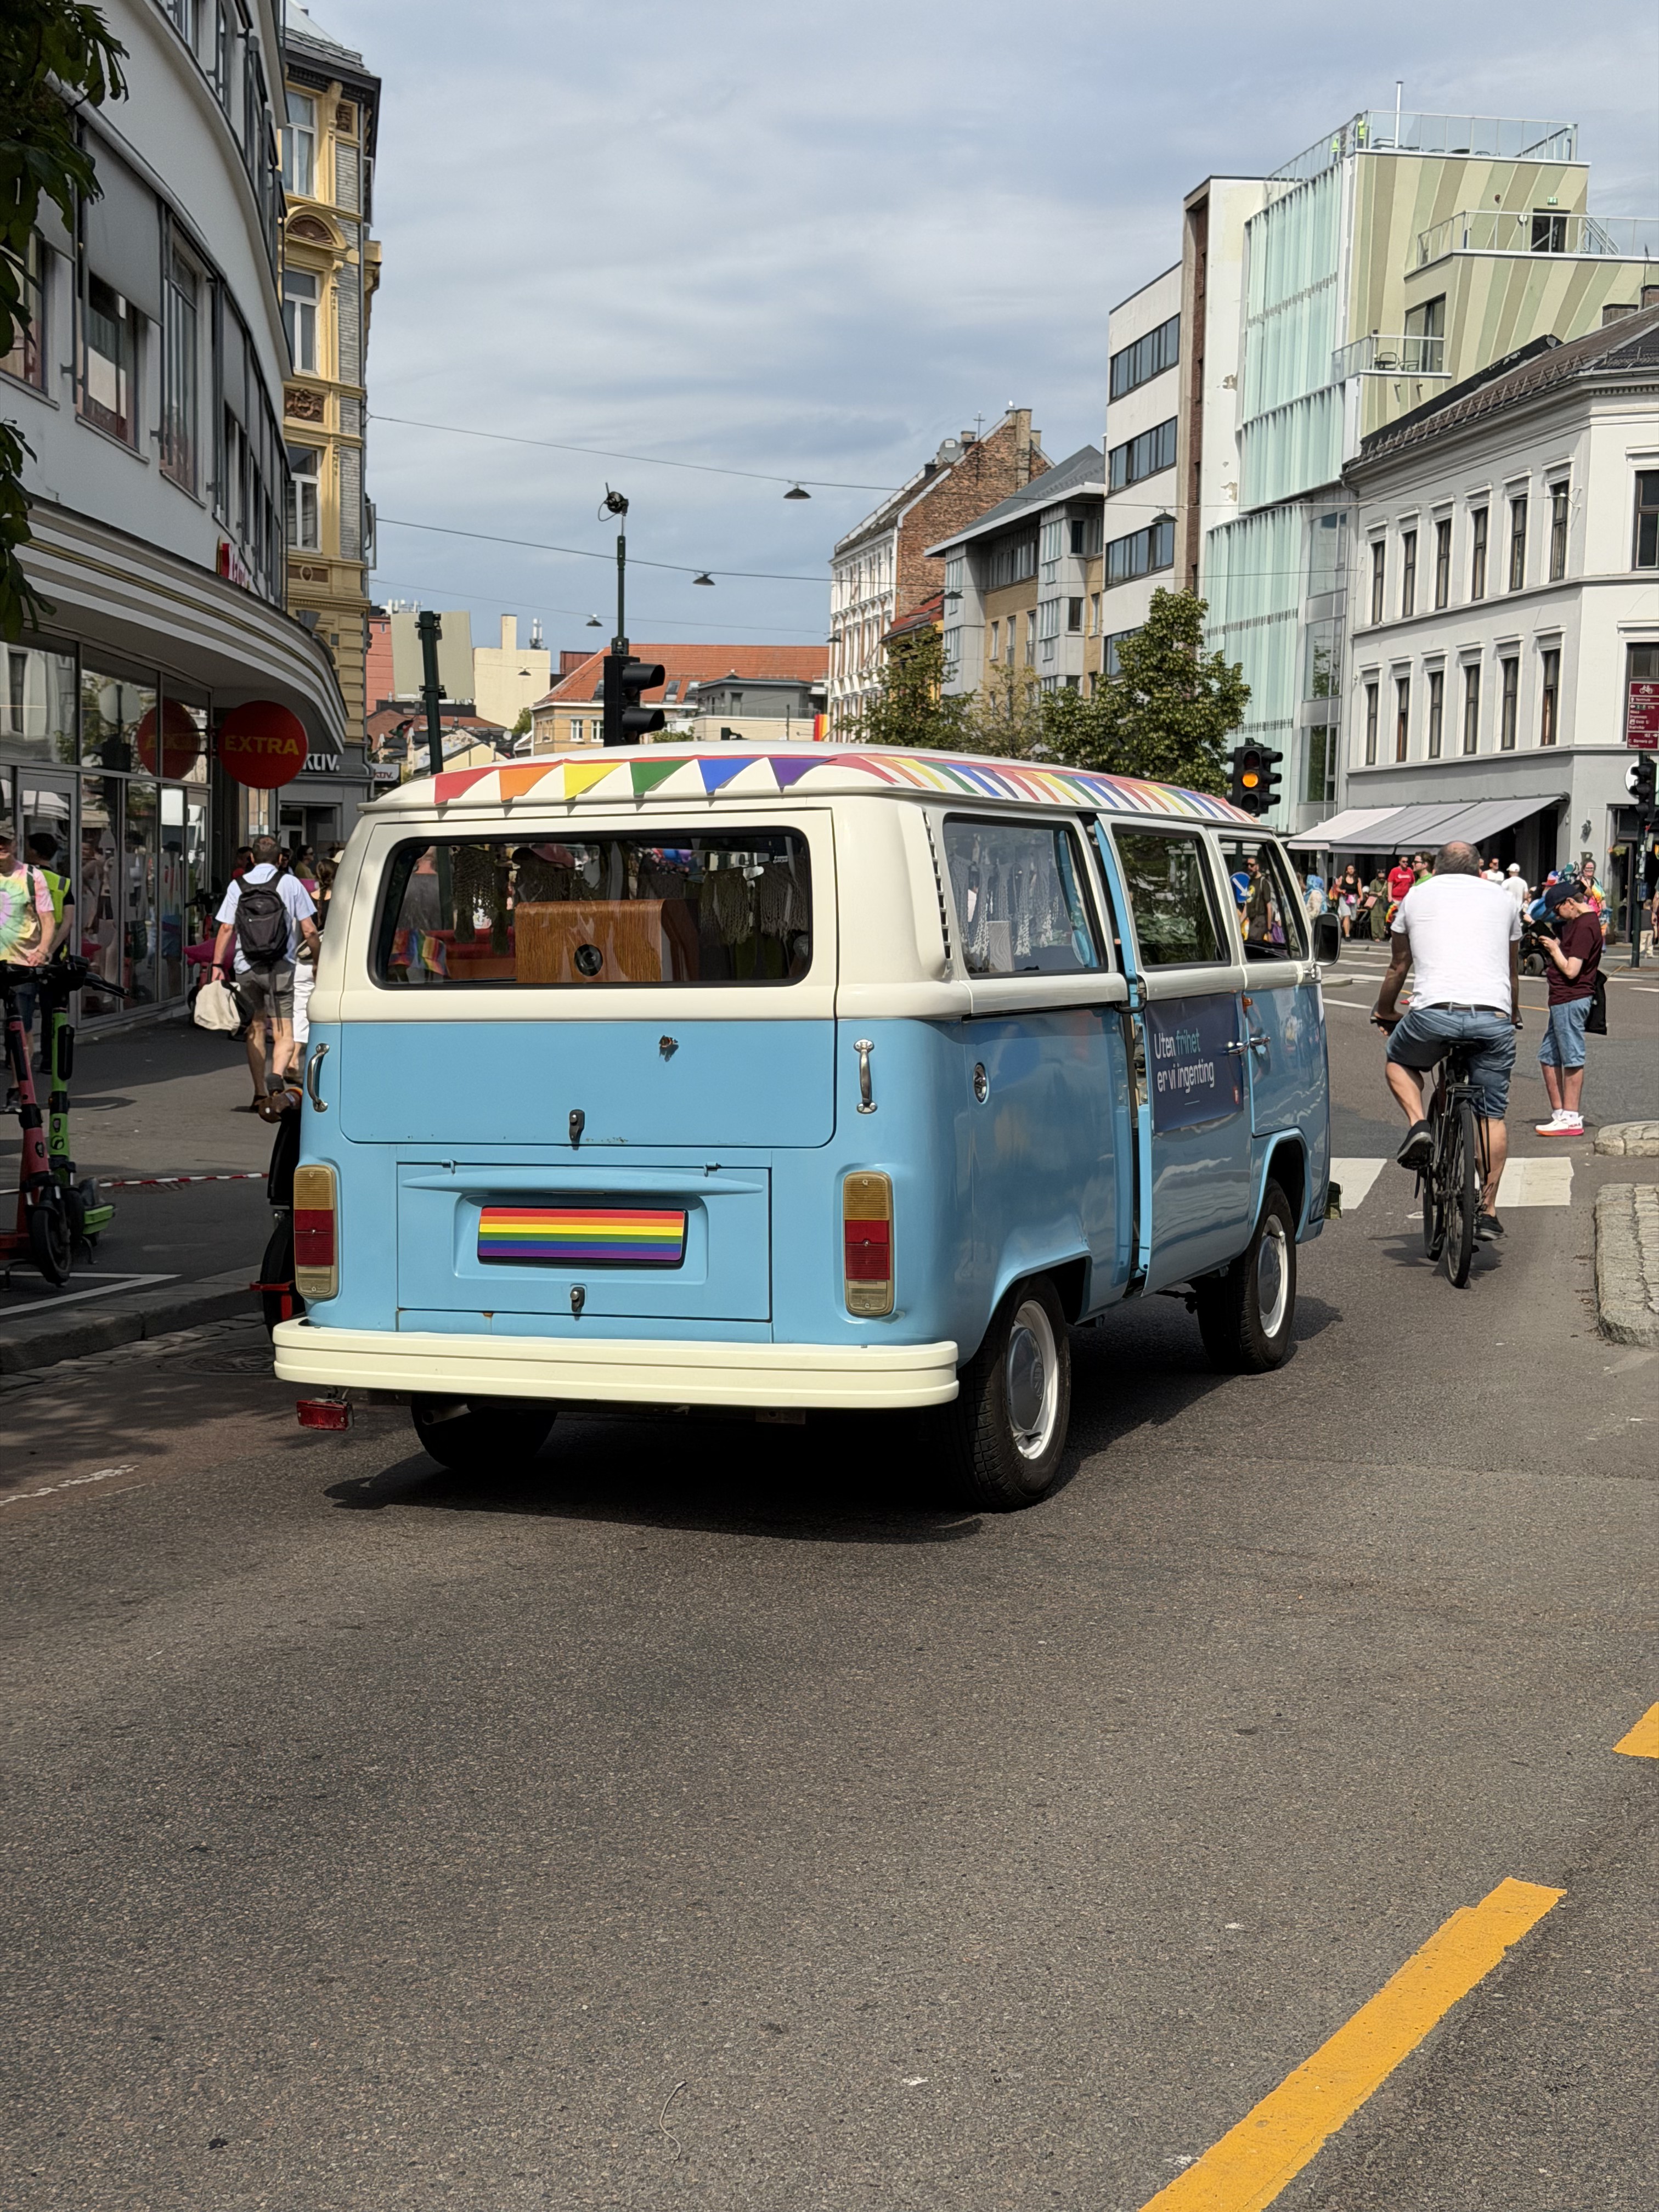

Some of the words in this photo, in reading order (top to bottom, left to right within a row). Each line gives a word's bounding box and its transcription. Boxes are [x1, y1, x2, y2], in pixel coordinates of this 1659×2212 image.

[225, 735, 300, 756] EXTRA
[1154, 1032, 1176, 1059] Uten
[1176, 1028, 1200, 1055] frihet
[1157, 1070, 1167, 1092] er
[1168, 1063, 1176, 1090] vi
[1177, 1058, 1215, 1093] ingenting
